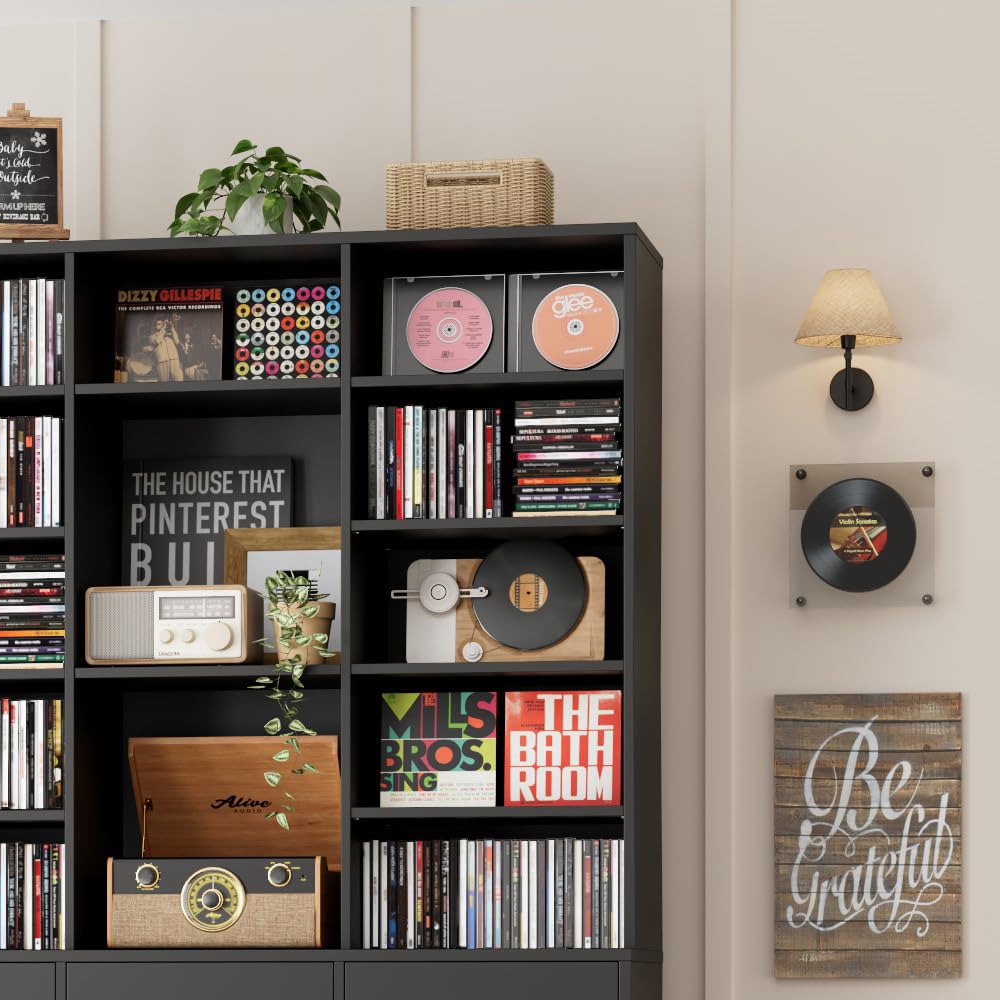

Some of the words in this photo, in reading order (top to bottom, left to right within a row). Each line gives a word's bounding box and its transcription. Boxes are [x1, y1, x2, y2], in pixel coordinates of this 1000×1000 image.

[117, 290, 158, 302] DIZZY
[160, 288, 222, 301] GILLESPIE
[551, 295, 594, 319] glee
[132, 472, 167, 496] THE
[172, 470, 234, 496] HOUSE
[238, 469, 286, 494] THAT
[130, 500, 285, 535] PINTEREST
[130, 541, 215, 586] BUI
[381, 691, 496, 738] MILLS
[537, 694, 615, 730] THE
[381, 739, 492, 772] BROS.
[510, 730, 614, 766] BATH
[380, 773, 438, 791] SING
[510, 766, 613, 802] ROOM
[803, 714, 925, 840] Be
[210, 795, 272, 809] Alive
[786, 792, 954, 938] Grateful
